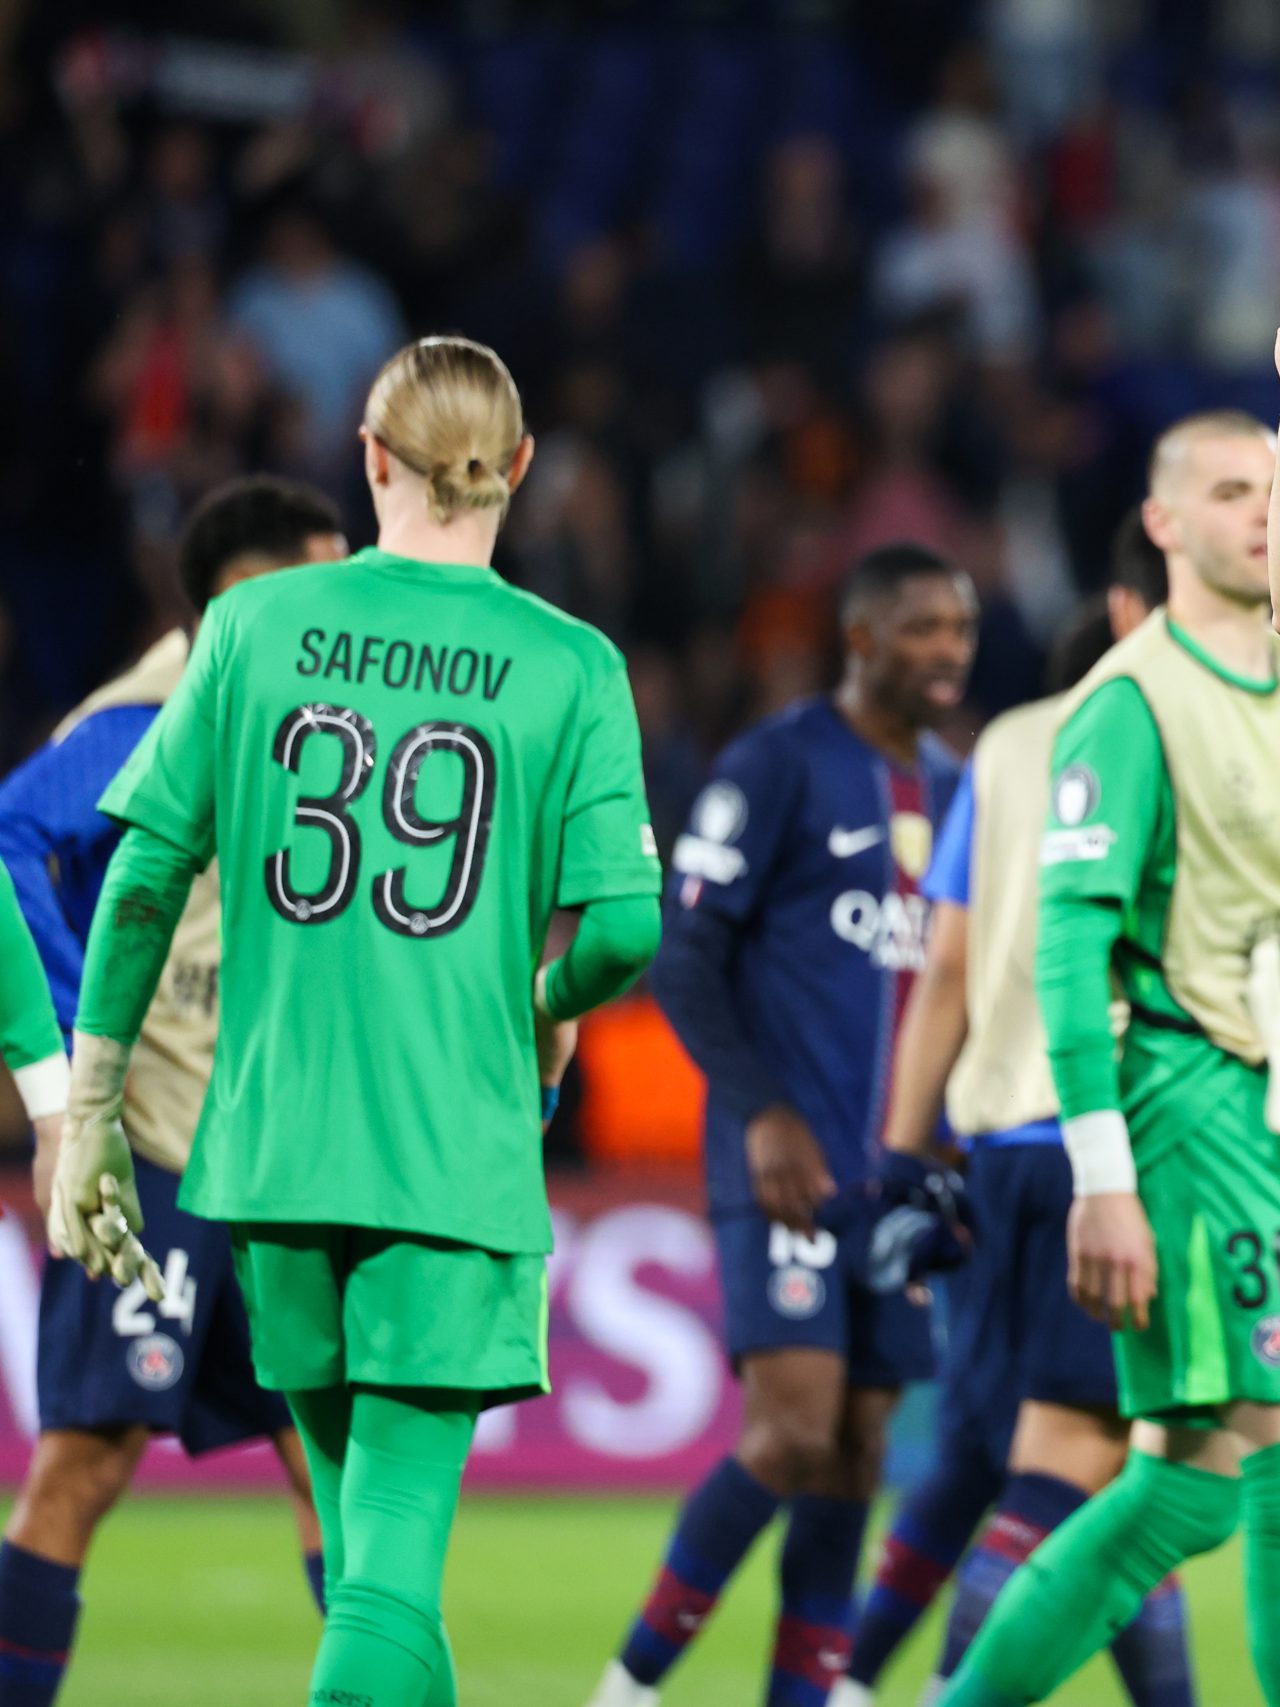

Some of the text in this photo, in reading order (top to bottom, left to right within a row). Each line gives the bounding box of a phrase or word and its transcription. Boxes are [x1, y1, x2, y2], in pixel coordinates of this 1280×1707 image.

[296, 627, 512, 702] SAFONOV
[264, 702, 497, 943] 39
[829, 888, 926, 953] QAT
[112, 1247, 198, 1337] 24
